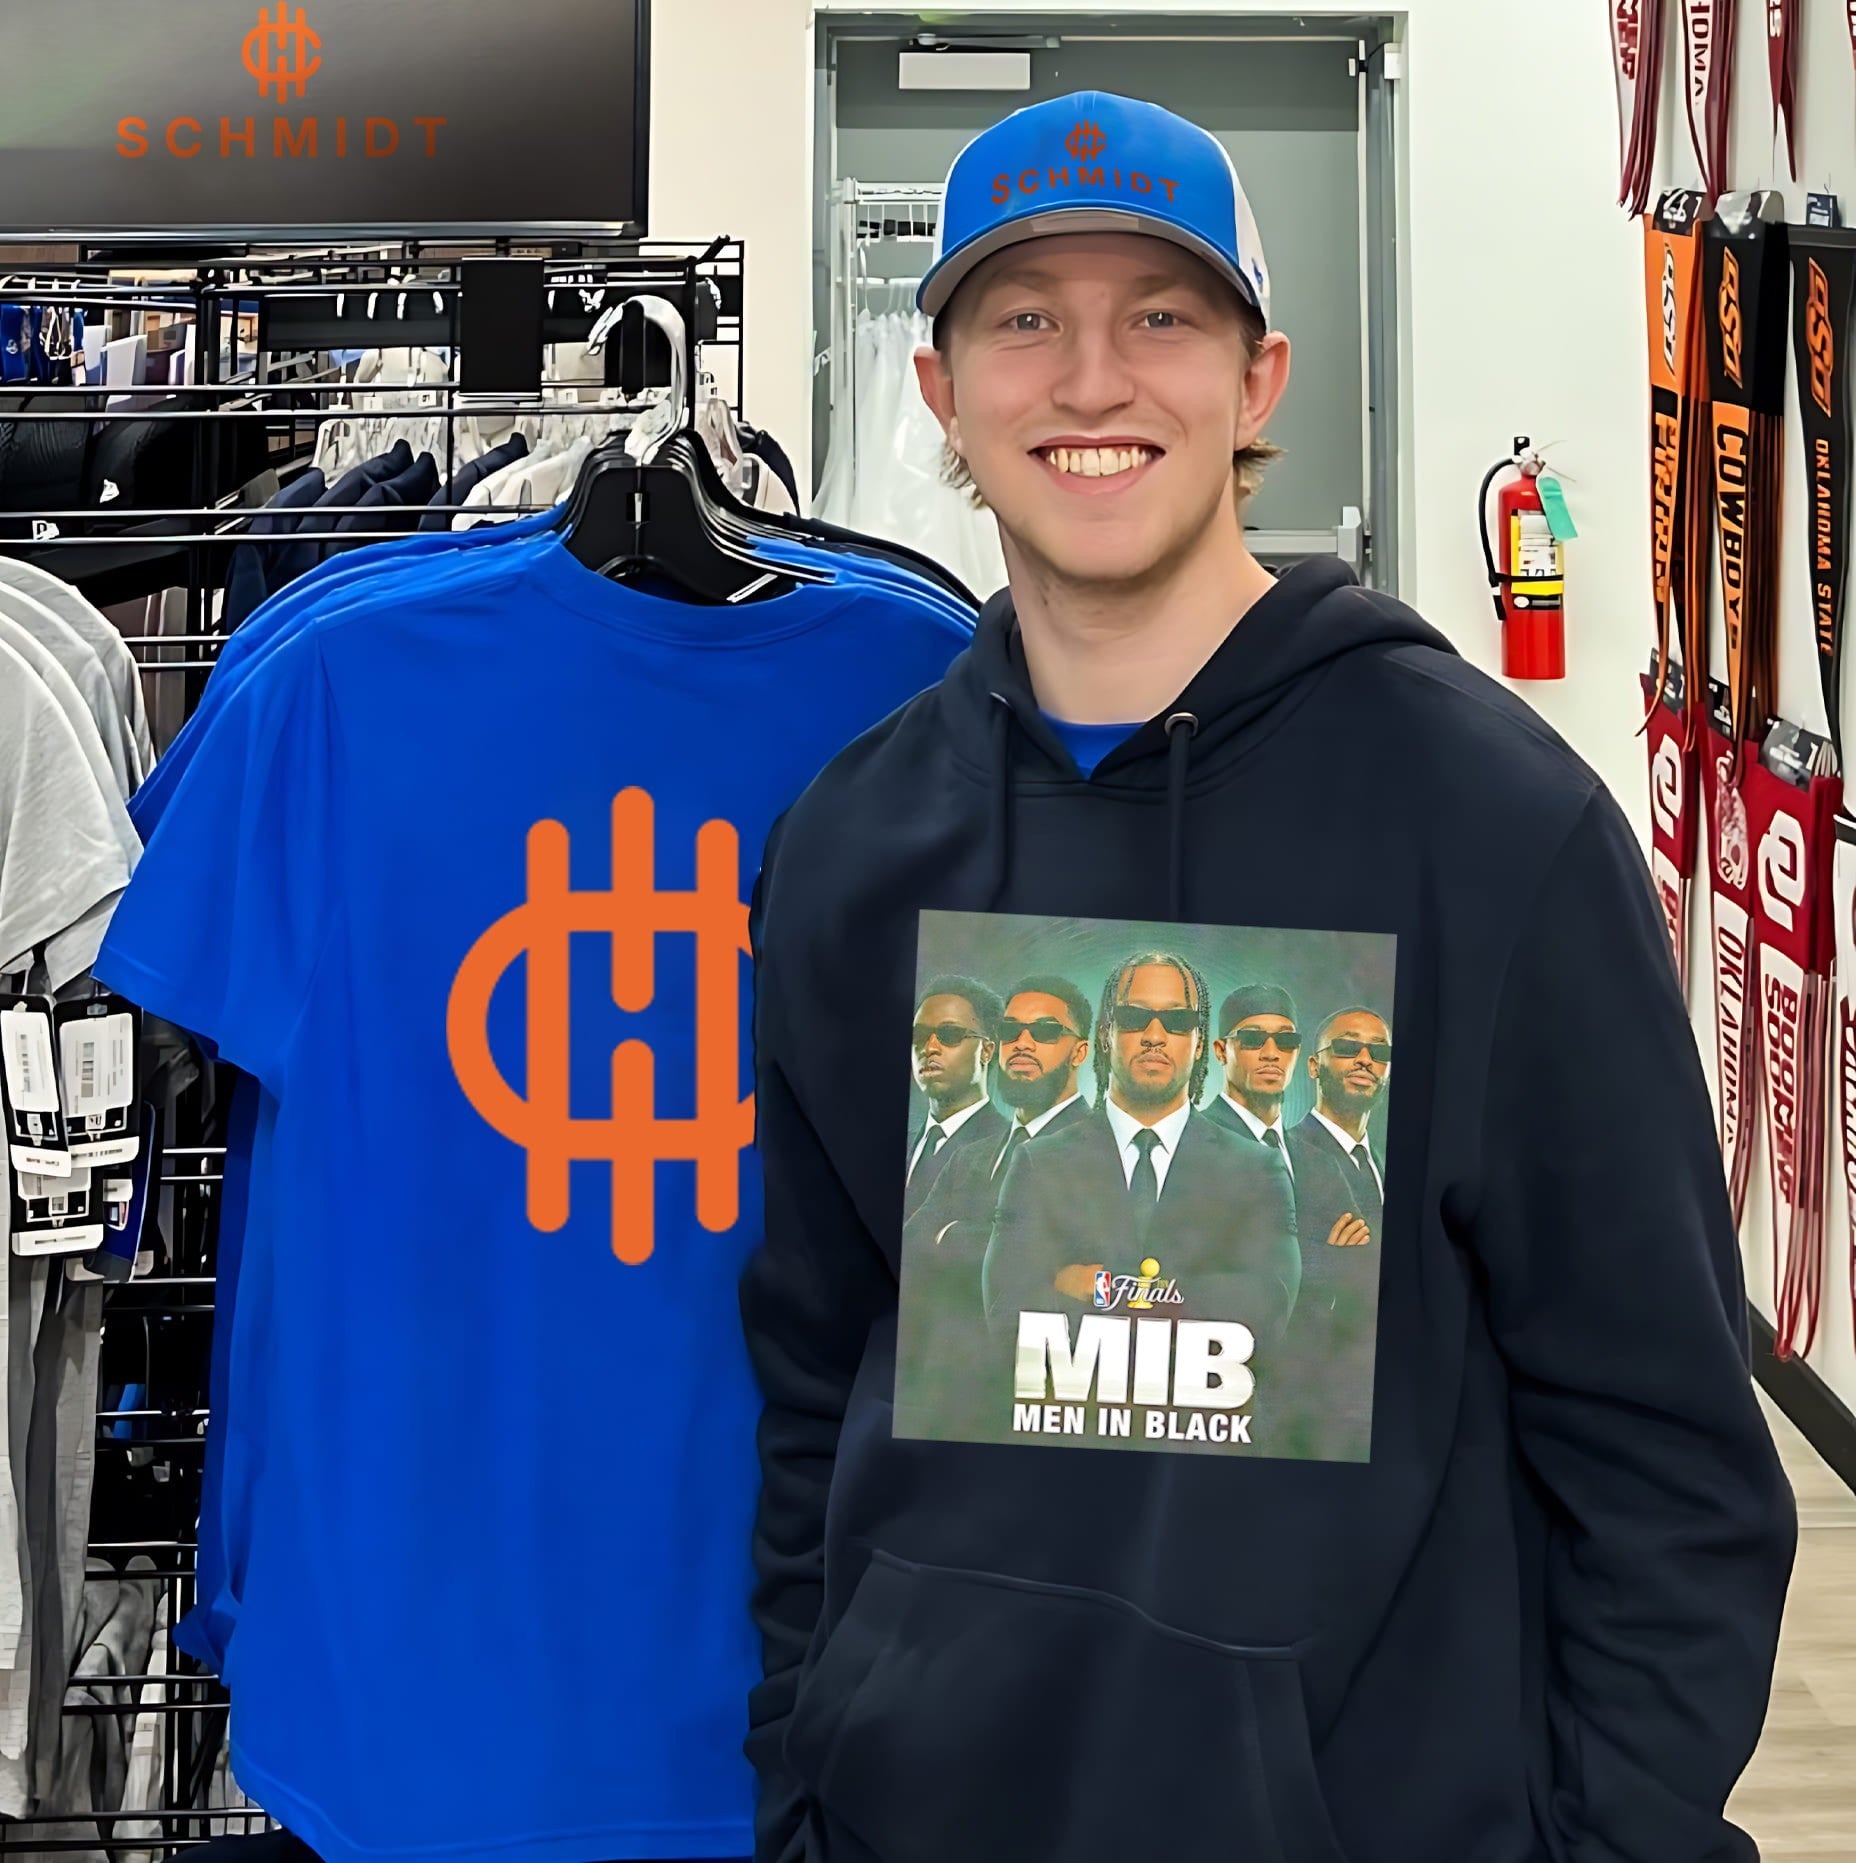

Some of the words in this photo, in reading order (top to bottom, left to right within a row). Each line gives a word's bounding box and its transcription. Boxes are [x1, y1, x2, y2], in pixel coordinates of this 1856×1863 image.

[115, 116, 448, 159] SCHMIDT
[991, 166, 1180, 205] SCHMIDT
[1815, 438, 1832, 570] OKLAHOMA
[1717, 926, 1745, 1144] OKLAHOMA
[1101, 1274, 1184, 1312] Finals
[1014, 1310, 1256, 1410] MIB
[1013, 1403, 1086, 1435] MEN
[1097, 1407, 1132, 1438] IN
[1144, 1410, 1253, 1444] BLACK
